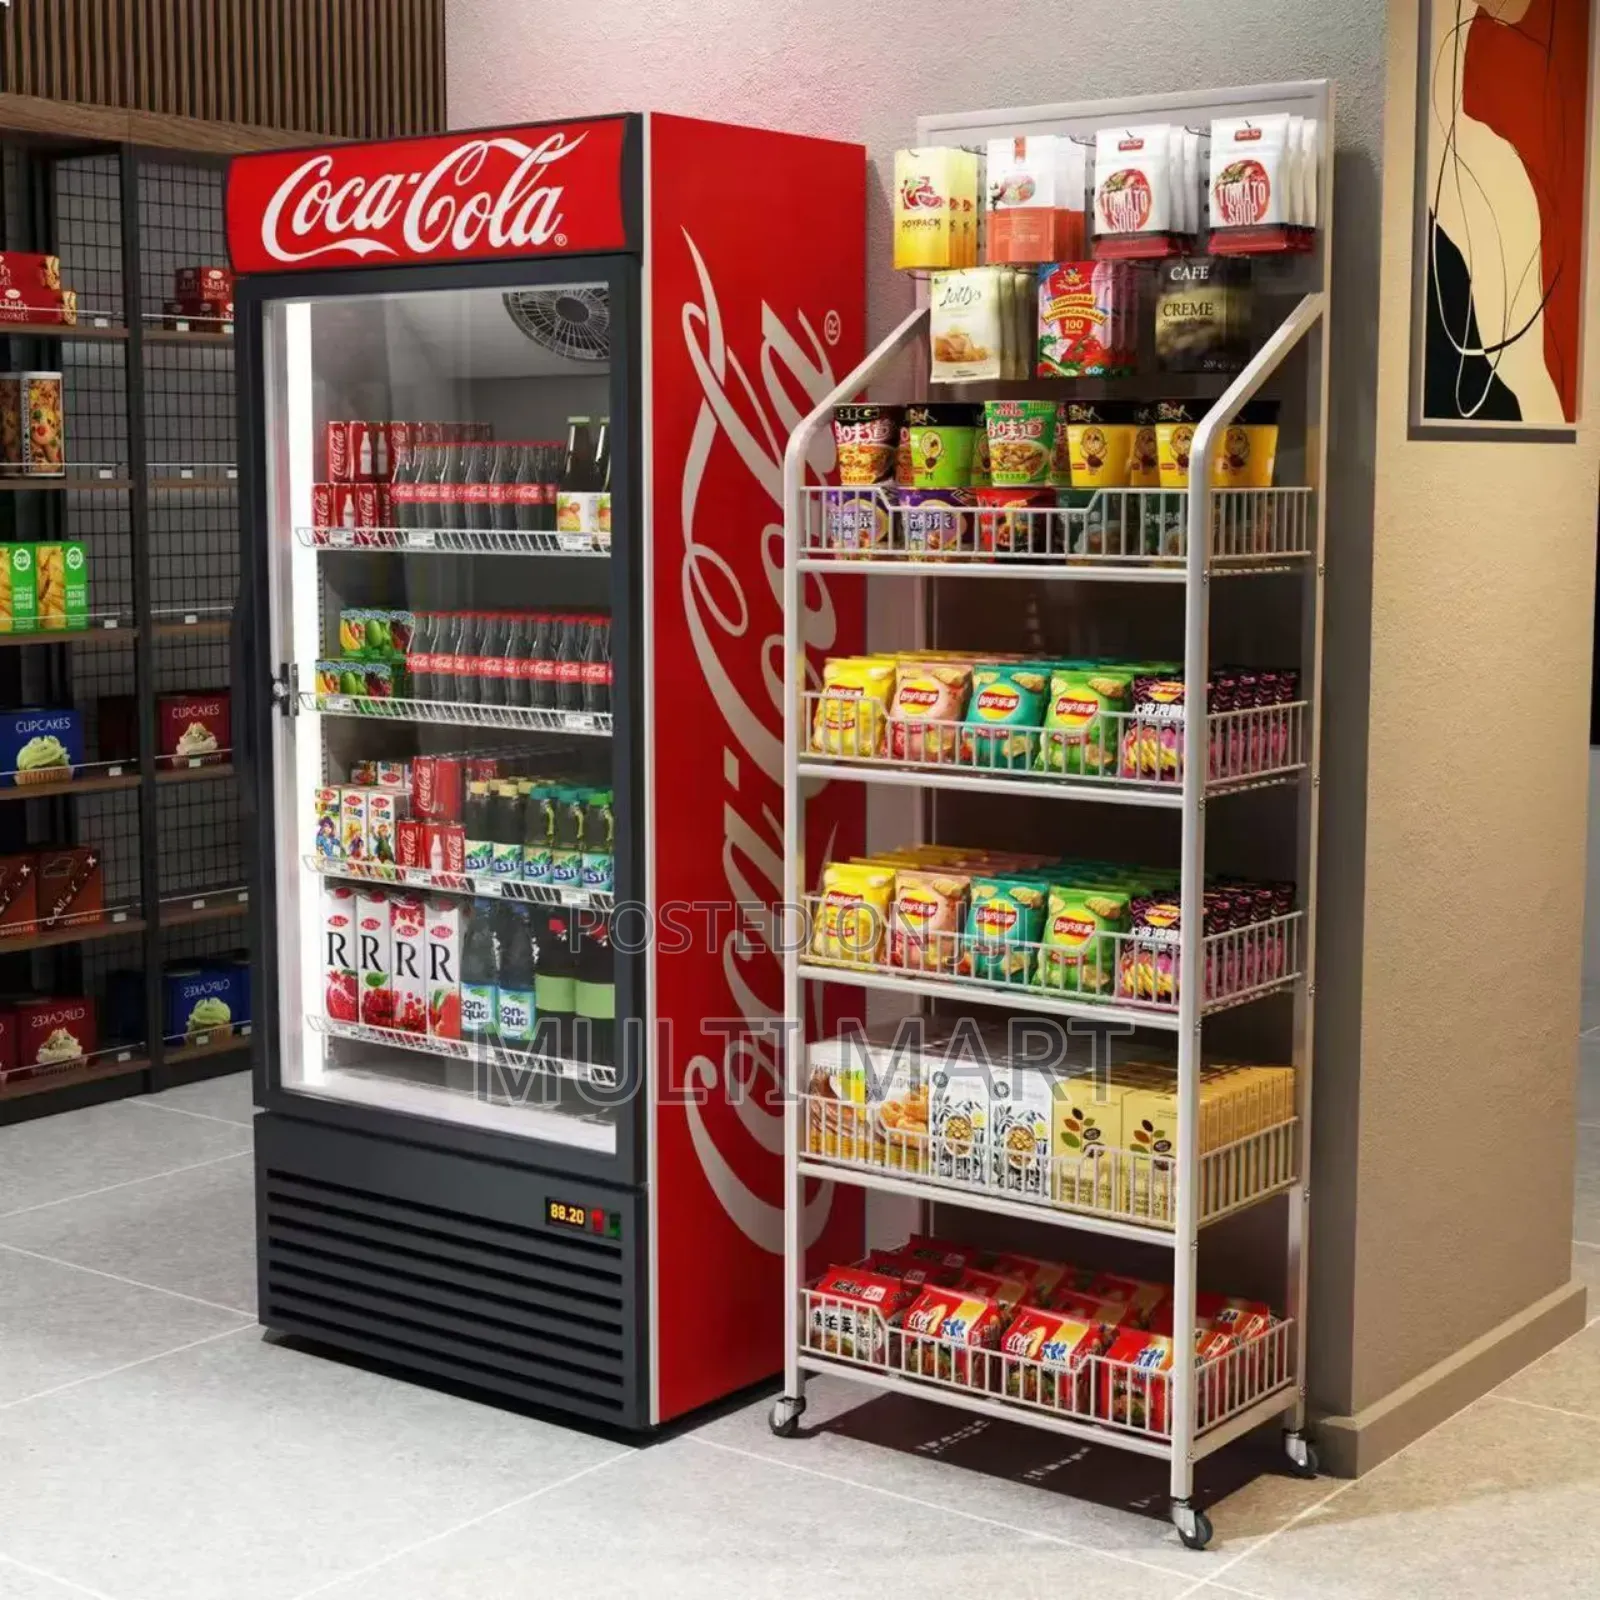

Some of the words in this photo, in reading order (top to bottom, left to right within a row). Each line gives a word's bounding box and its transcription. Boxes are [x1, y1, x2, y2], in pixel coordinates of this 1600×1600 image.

[261, 130, 590, 262] Coca-Cola
[1102, 188, 1148, 213] TOMATO
[1218, 180, 1266, 205] TOMATO
[1111, 208, 1140, 231] SOUP
[1227, 202, 1258, 225] SOUP
[1170, 266, 1209, 280] CAFE
[1065, 319, 1084, 329] 100
[837, 407, 880, 421] BIG
[171, 704, 220, 719] CUPCAKES
[15, 717, 71, 734] CUPCAKES
[327, 931, 350, 968] R
[360, 934, 383, 972] R
[396, 941, 420, 979] R
[430, 943, 455, 983] R
[550, 1203, 584, 1225] 88.20
